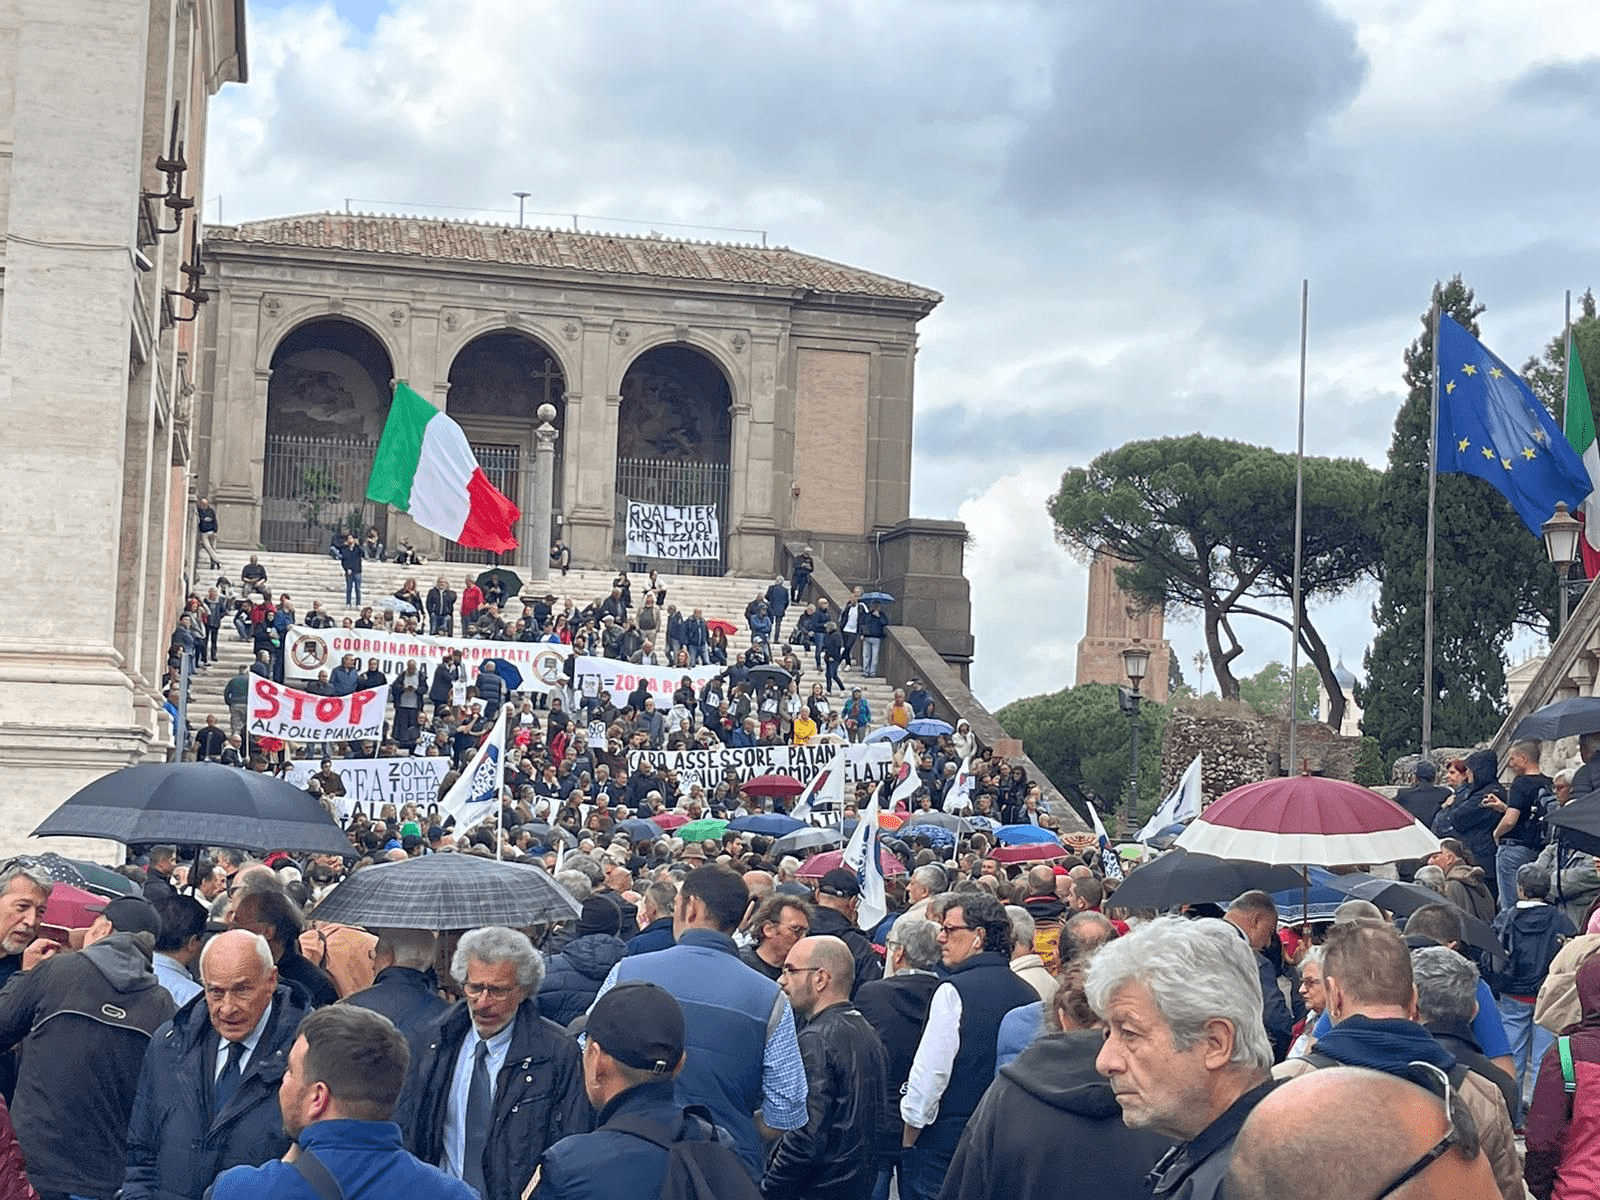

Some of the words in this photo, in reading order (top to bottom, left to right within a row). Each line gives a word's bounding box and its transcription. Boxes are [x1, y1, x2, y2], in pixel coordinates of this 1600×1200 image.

[630, 515, 664, 534] NON
[674, 520, 712, 534] PUOI
[657, 542, 718, 557] ROMANI
[462, 648, 530, 662] COMITATI
[254, 680, 377, 725] STOP
[252, 719, 273, 734] AL
[279, 724, 322, 738] FOLLE
[324, 727, 363, 740] PIANO
[674, 747, 775, 770] ASSESSORE
[389, 762, 435, 777] ZONA
[389, 777, 440, 793] TUTTA
